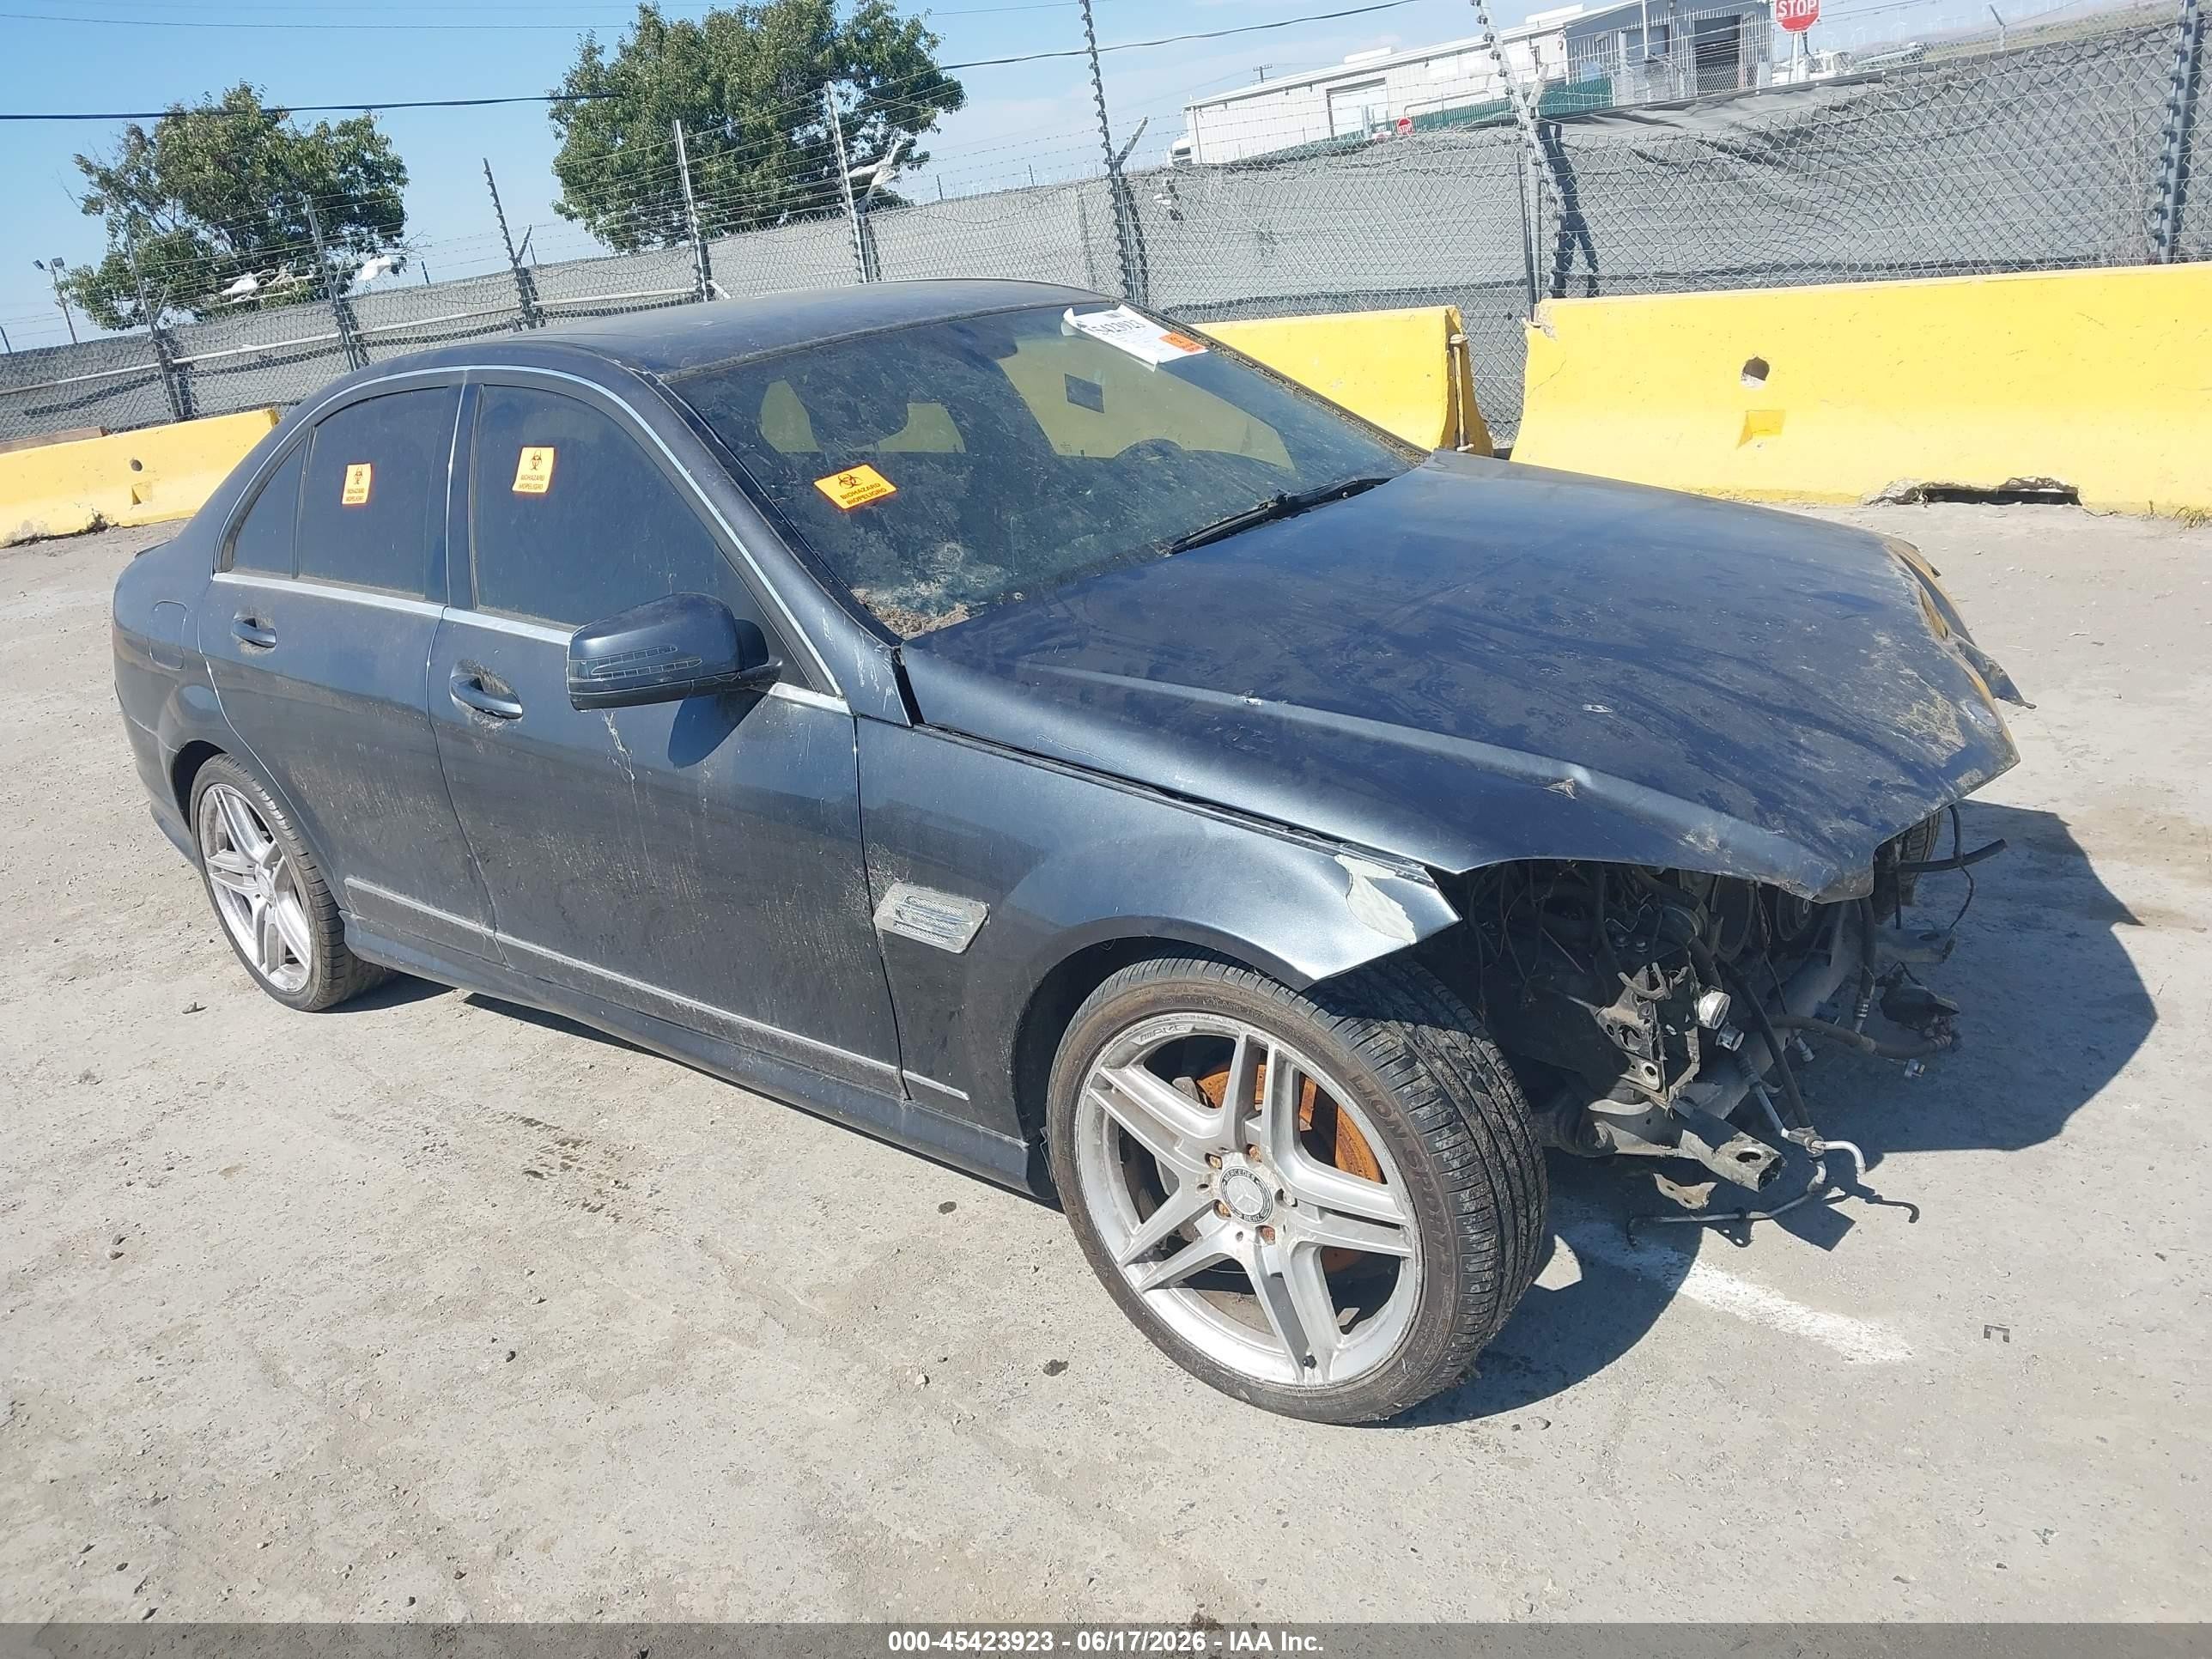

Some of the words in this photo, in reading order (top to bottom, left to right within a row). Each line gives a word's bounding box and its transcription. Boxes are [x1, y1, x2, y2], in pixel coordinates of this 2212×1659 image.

[1778, 0, 1817, 17] STOP
[1398, 123, 1412, 133] STOP
[840, 482, 881, 500] BIOHAZARD
[846, 487, 887, 505] BIOPELIGRO
[1224, 1168, 1255, 1181] MERCEDES
[1243, 1213, 1262, 1222] BENZ
